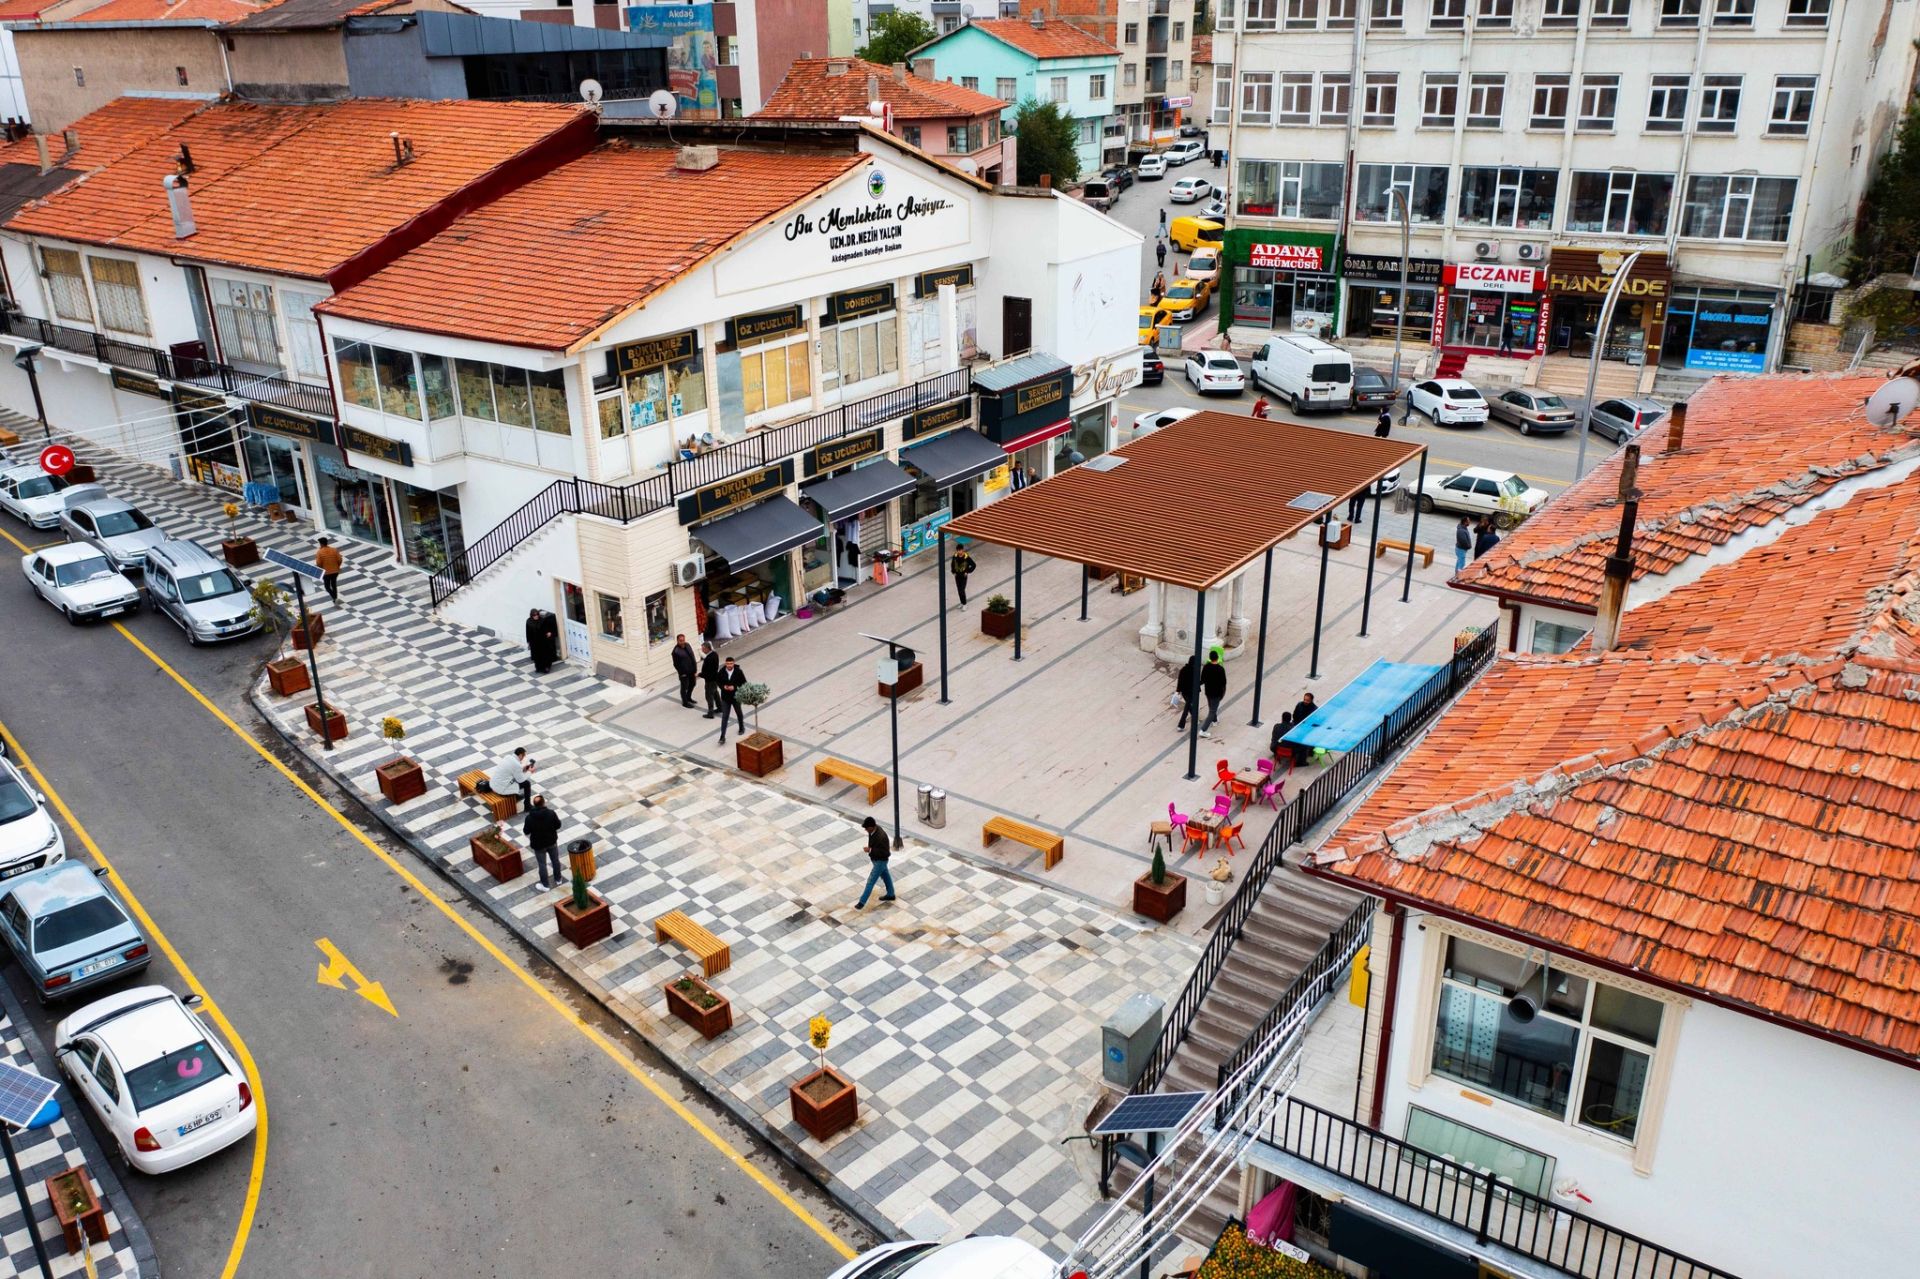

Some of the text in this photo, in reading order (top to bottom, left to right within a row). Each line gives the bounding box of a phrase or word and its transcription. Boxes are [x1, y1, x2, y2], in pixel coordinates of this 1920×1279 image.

[785, 213, 813, 241] Bu
[818, 203, 892, 234] Memleketin
[879, 225, 902, 241] YALÇIN
[1252, 243, 1319, 259] ADANA
[1252, 256, 1318, 270] DÜRÜMCÜSÜ
[1459, 266, 1531, 283] ECZANE
[739, 314, 794, 336] ÖZ UCUZLUK
[1537, 303, 1550, 350] ECZANE
[821, 439, 873, 465] ÖZ UCUZLUK
[714, 471, 766, 499] BÜKÜLMEZ
